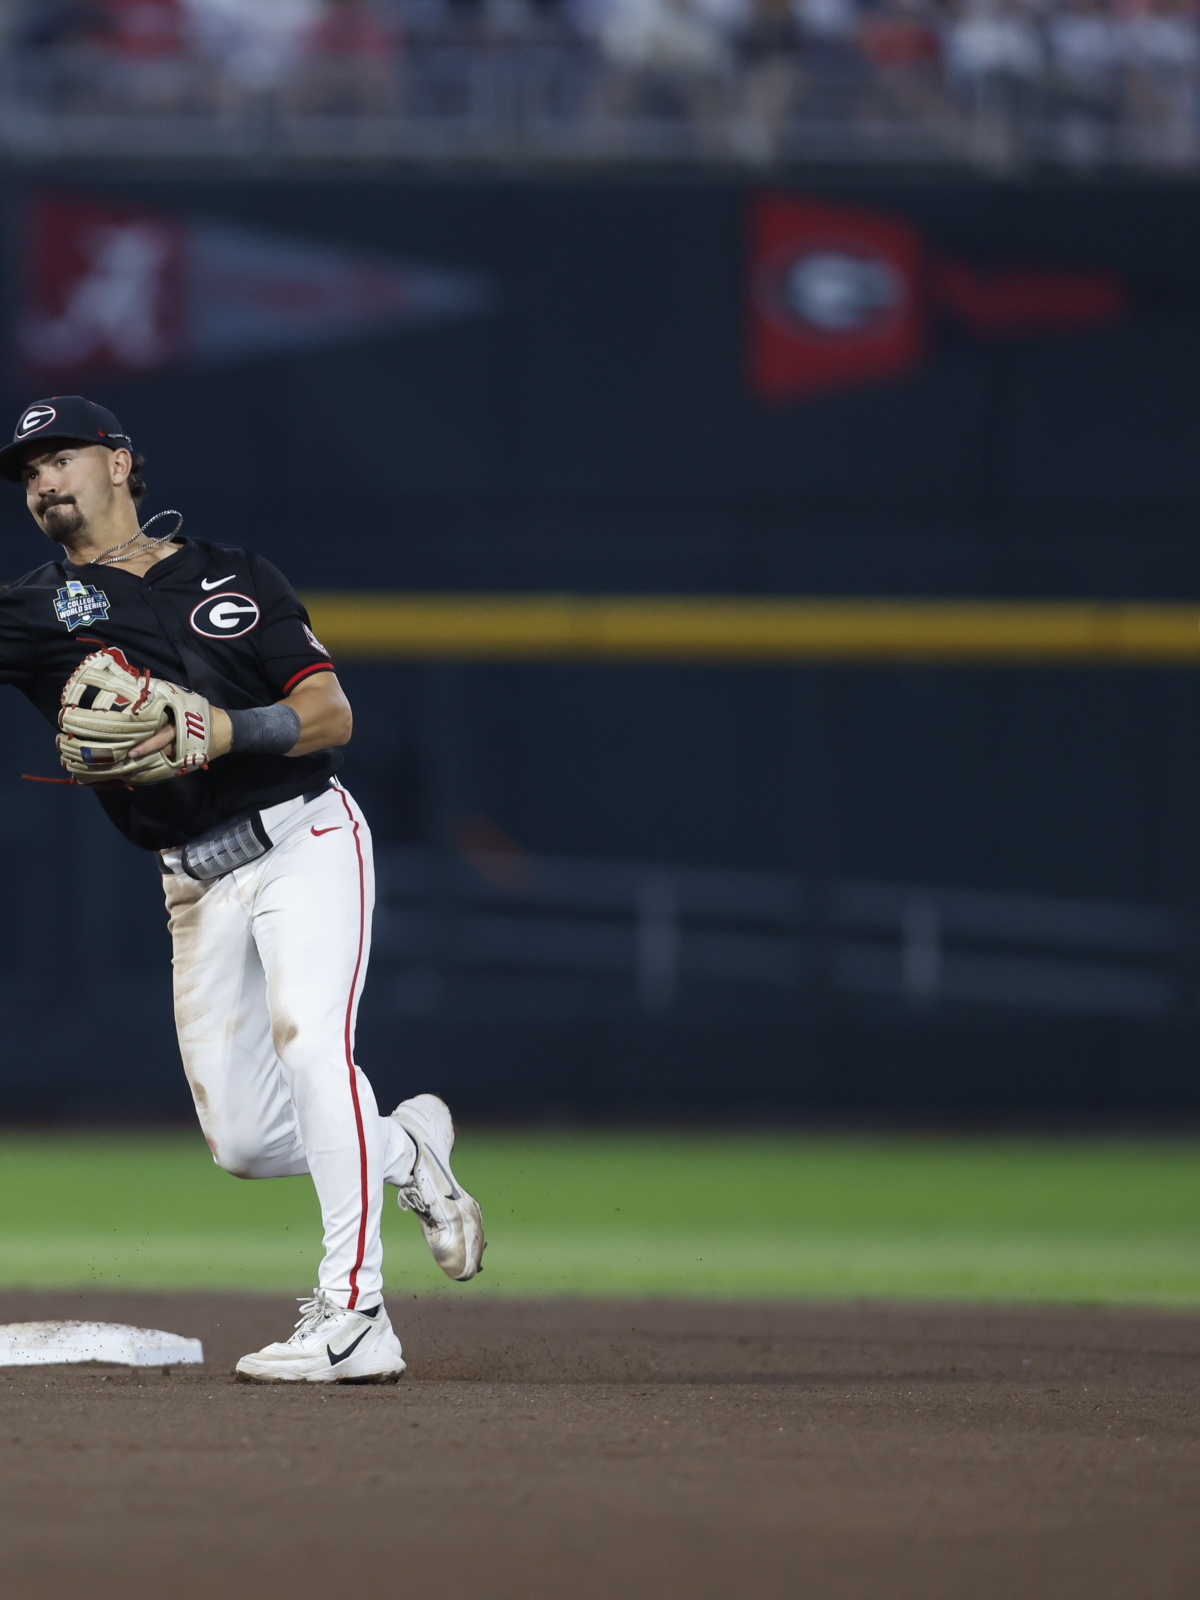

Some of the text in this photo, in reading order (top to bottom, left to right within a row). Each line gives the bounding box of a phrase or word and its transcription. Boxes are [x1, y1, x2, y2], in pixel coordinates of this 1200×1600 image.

[60, 605, 83, 619] WORLD
[84, 601, 107, 611] SERIES
[67, 597, 95, 609] COLLEGE
[209, 601, 258, 629] G
